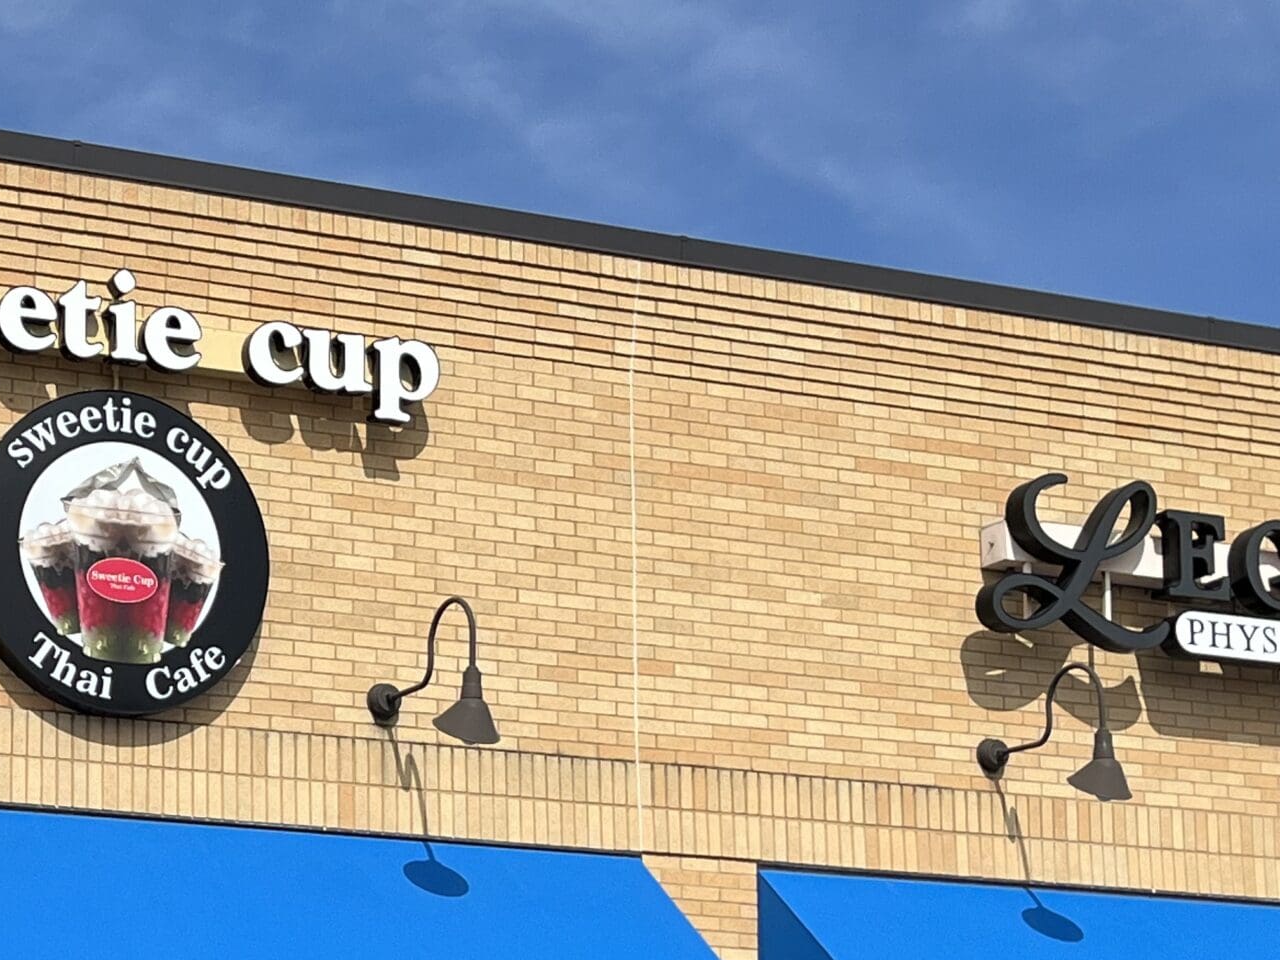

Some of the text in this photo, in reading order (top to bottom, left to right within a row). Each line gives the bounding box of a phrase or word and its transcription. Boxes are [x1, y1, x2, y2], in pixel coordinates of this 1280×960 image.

[242, 320, 441, 424] cup
[7, 396, 232, 490] sweetie cup
[91, 570, 155, 588] Sweetie Cup
[28, 631, 226, 700] Thai Cafe
[1186, 617, 1278, 655] PHYS
